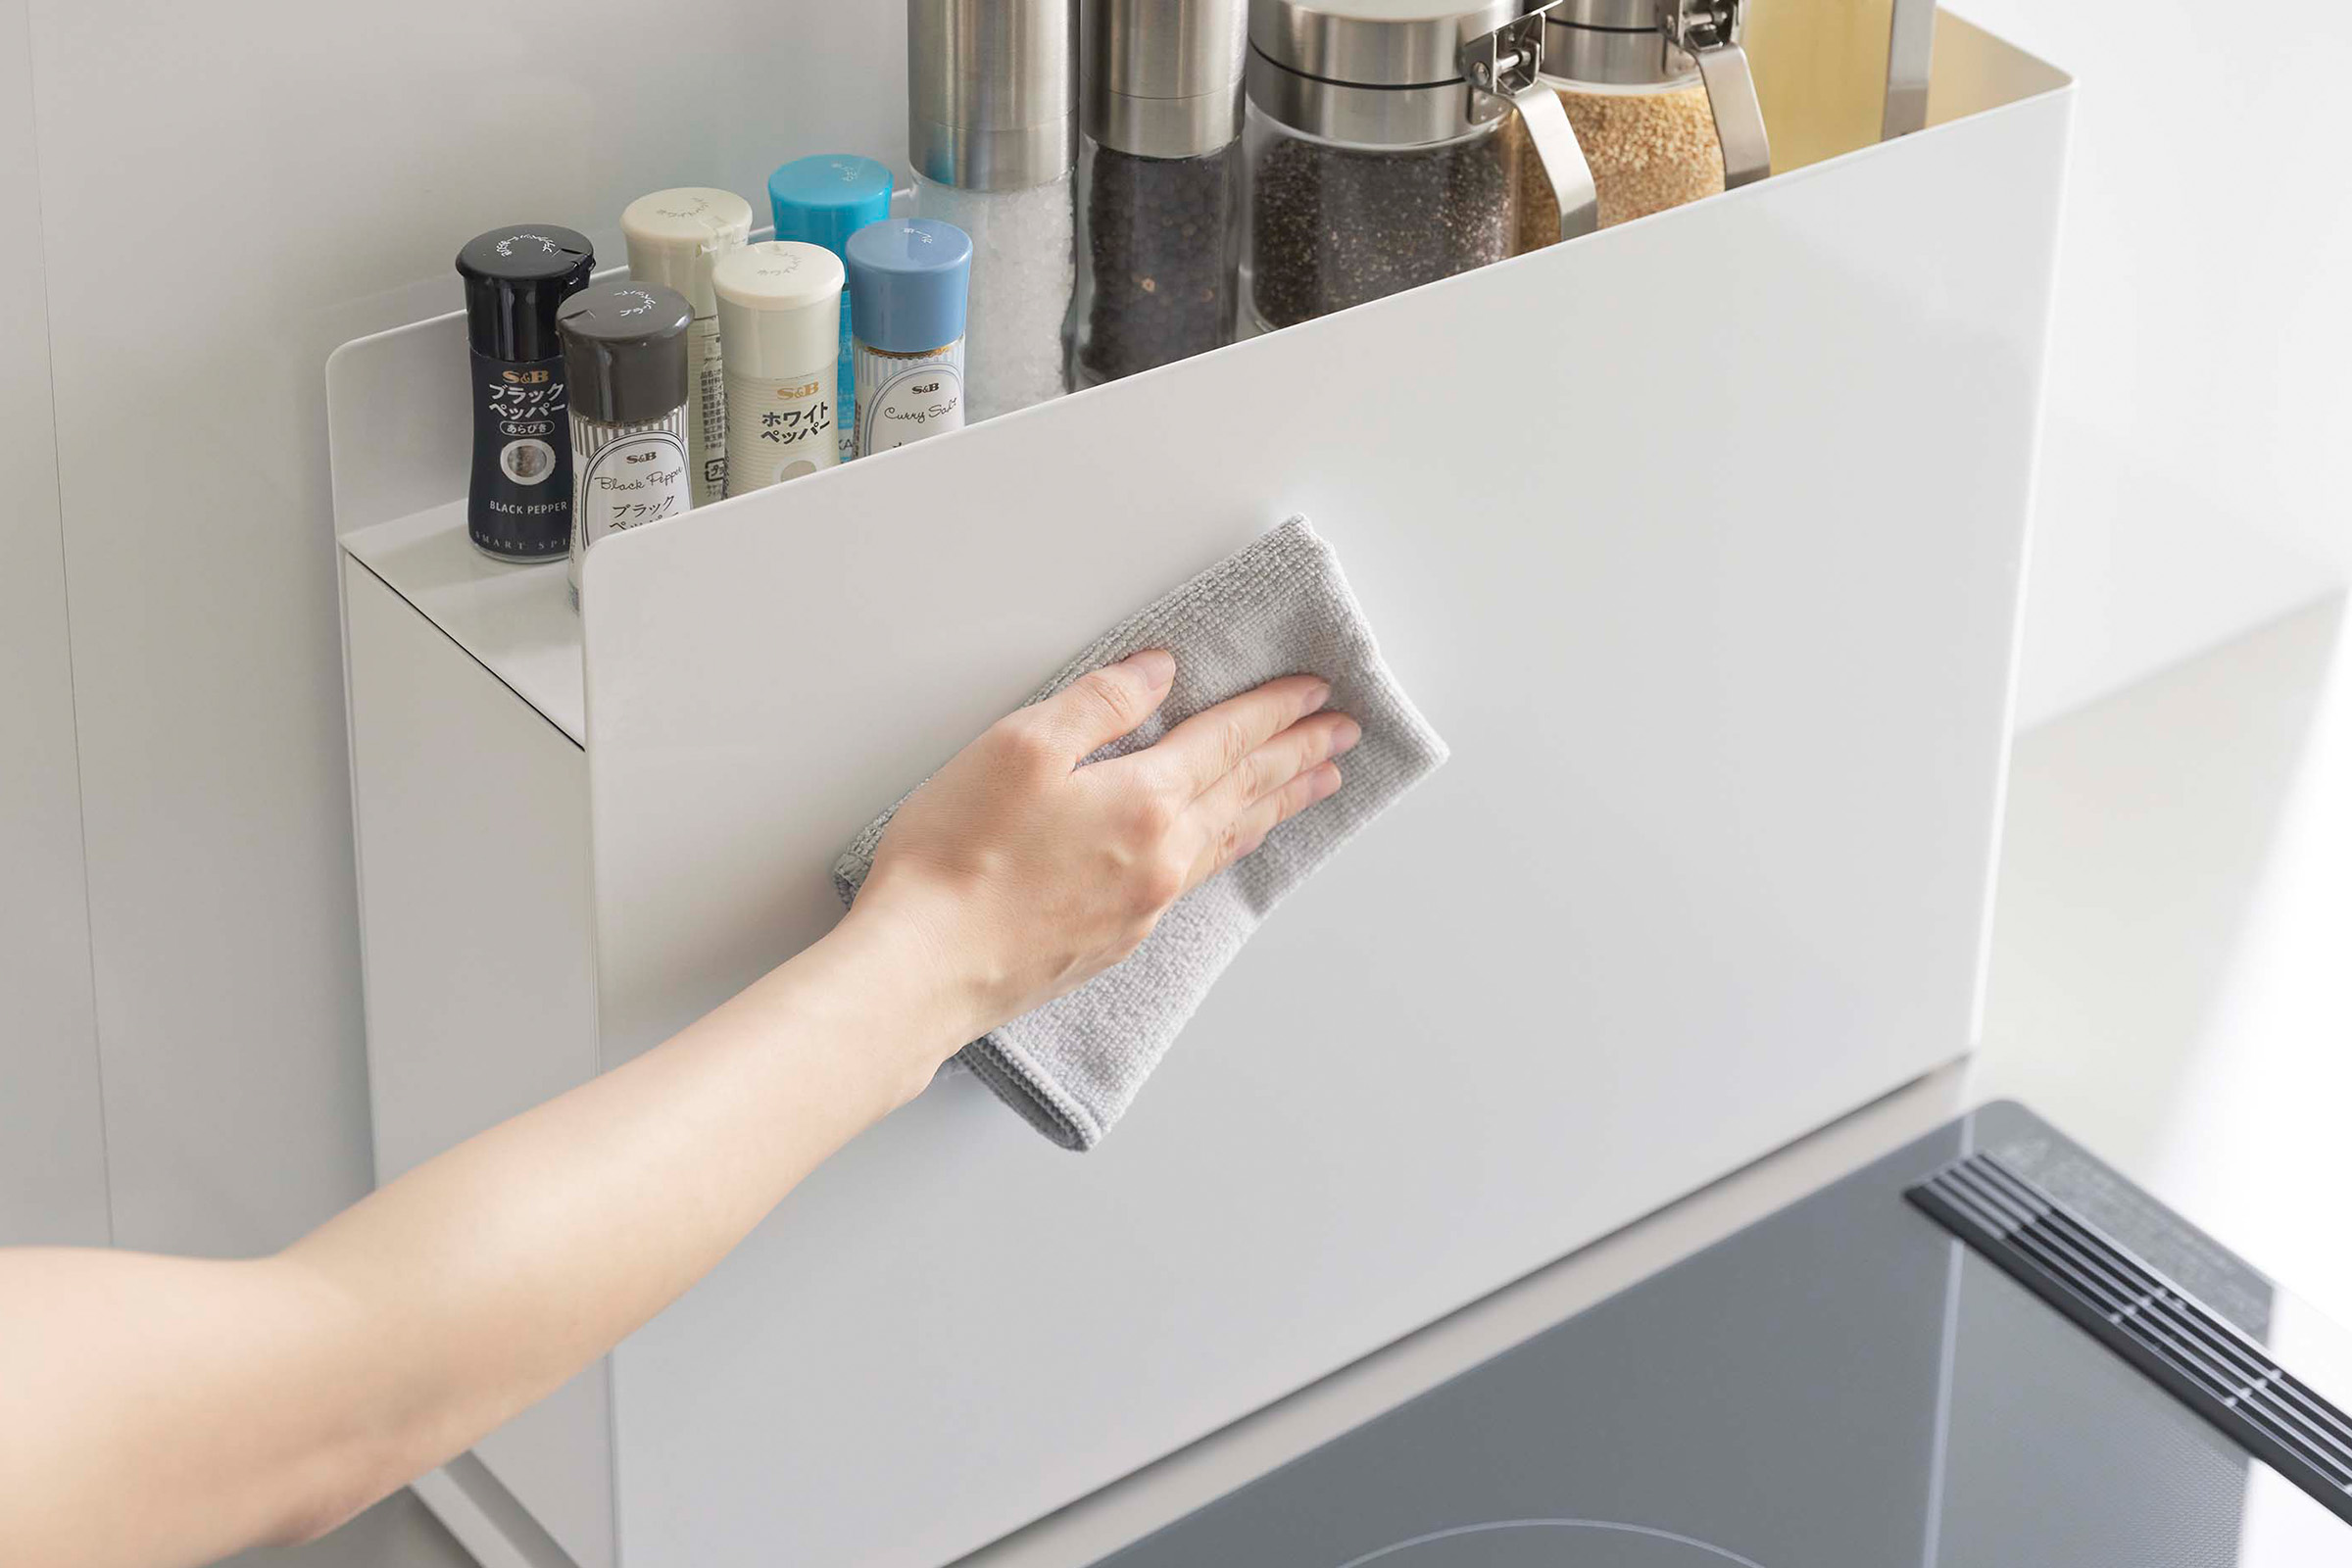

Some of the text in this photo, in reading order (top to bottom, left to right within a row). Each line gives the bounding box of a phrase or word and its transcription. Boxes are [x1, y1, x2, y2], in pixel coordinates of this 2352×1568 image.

[502, 369, 550, 384] S&B
[489, 382, 564, 405] ブラック
[776, 381, 819, 400] S&B
[911, 382, 939, 395] S&B
[489, 402, 566, 420] ペッパー
[761, 402, 829, 428] ホワイト
[884, 397, 957, 423] Curry Salt
[507, 423, 548, 434] あらびき
[760, 420, 831, 445] ペッパー
[626, 451, 658, 464] S&B
[594, 466, 683, 491] Black Pepper
[489, 500, 567, 514] BLACK PEPPER
[612, 495, 675, 518] ブラック
[538, 537, 568, 551] SPI
